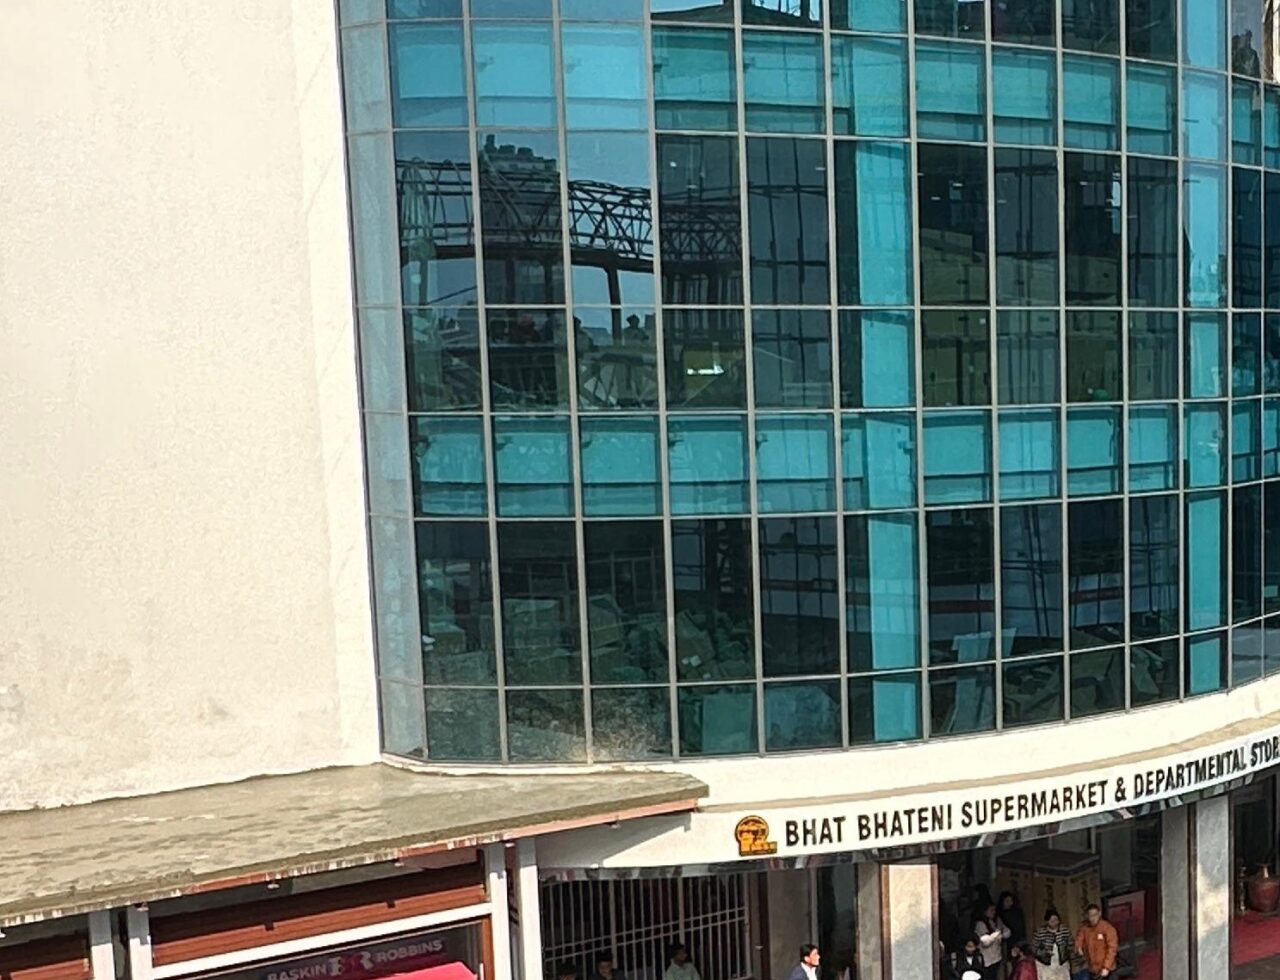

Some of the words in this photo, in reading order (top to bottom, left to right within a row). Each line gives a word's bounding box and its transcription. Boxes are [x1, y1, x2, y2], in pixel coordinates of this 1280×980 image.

[785, 816, 846, 847] BHAT
[858, 804, 951, 840] BHATENI
[961, 779, 1108, 828] SUPERMARKET
[1114, 776, 1127, 802] &
[1133, 746, 1247, 798] DEPARTMENTAL
[375, 939, 443, 963] ROBBINS
